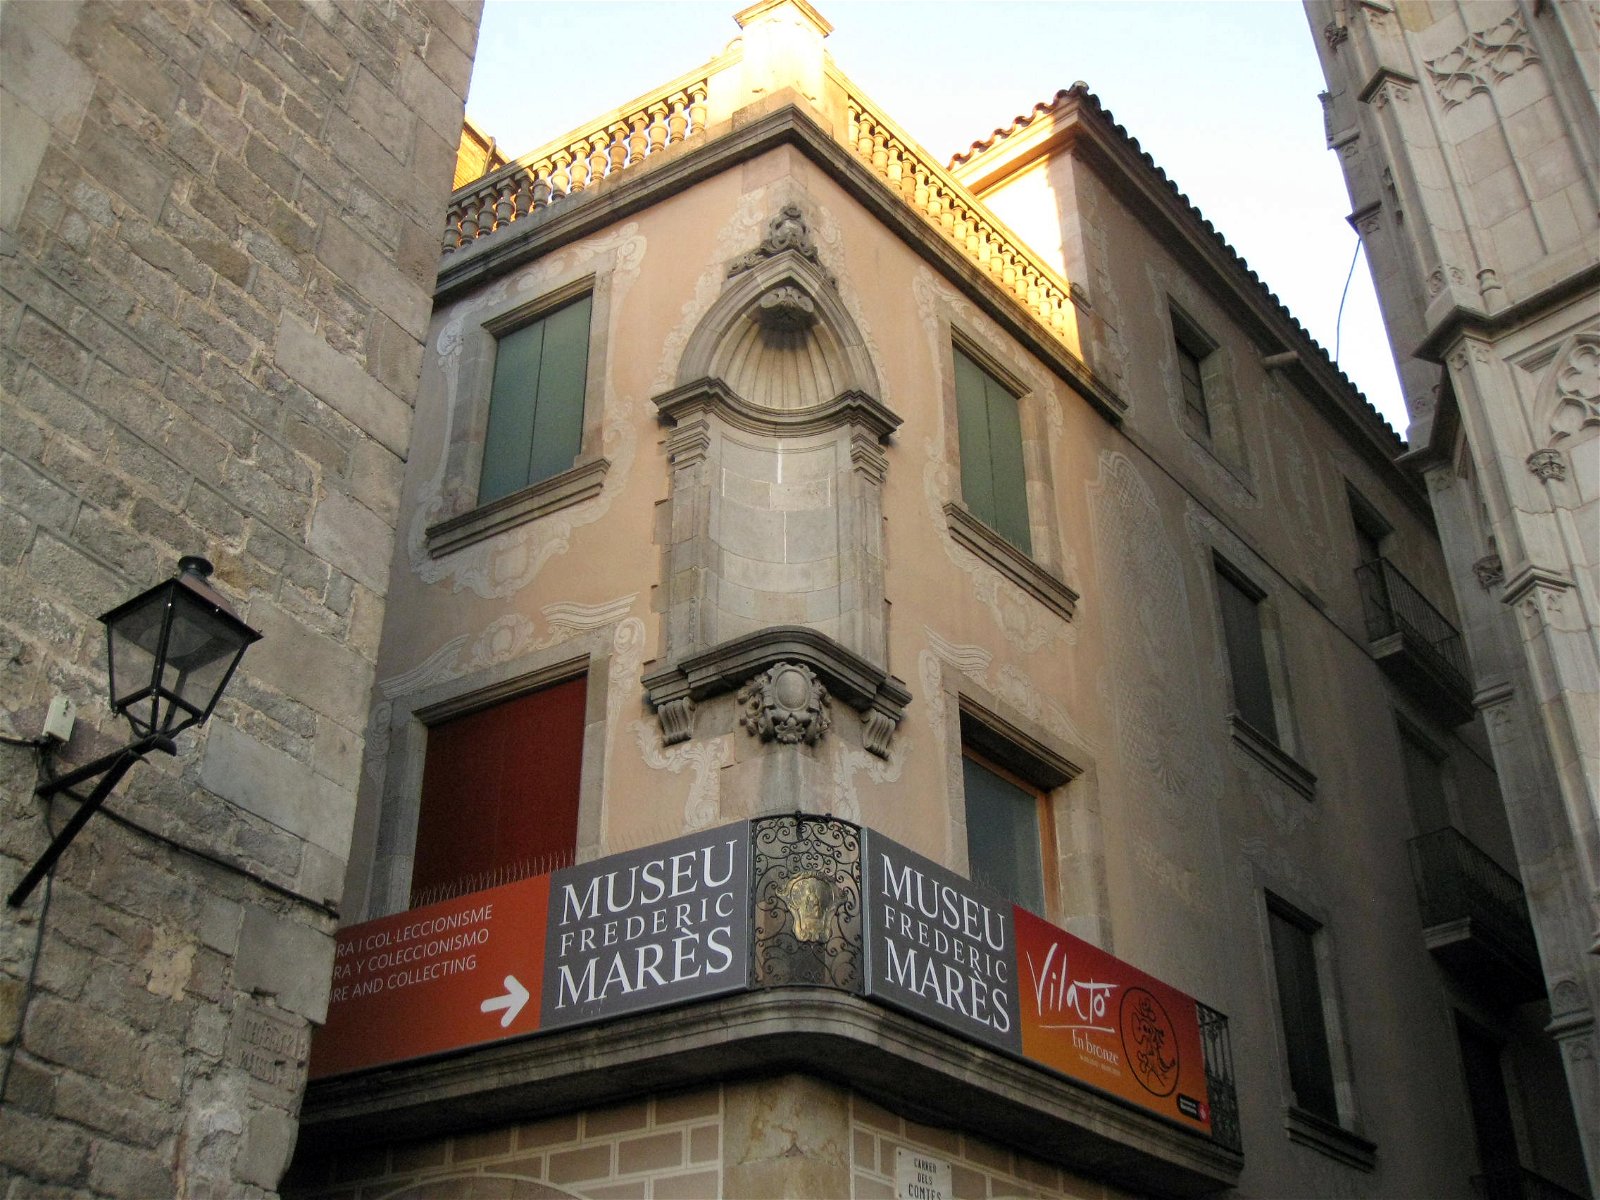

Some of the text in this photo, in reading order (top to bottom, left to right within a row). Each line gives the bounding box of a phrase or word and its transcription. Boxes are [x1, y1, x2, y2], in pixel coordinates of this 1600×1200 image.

[559, 839, 738, 926] MUSEU
[880, 852, 1006, 951] MUSEU
[356, 959, 366, 975] Y
[368, 928, 490, 973] COLECCIONISMO
[358, 937, 363, 951] I
[558, 892, 735, 958] FREDERIC
[884, 904, 1008, 984] FREDERIC
[352, 977, 384, 1000] AND
[387, 954, 477, 990] COLLECTING
[554, 925, 734, 1010] MARÈS
[884, 936, 1011, 1034] MARÈS
[1085, 1032, 1120, 1065] bronze
